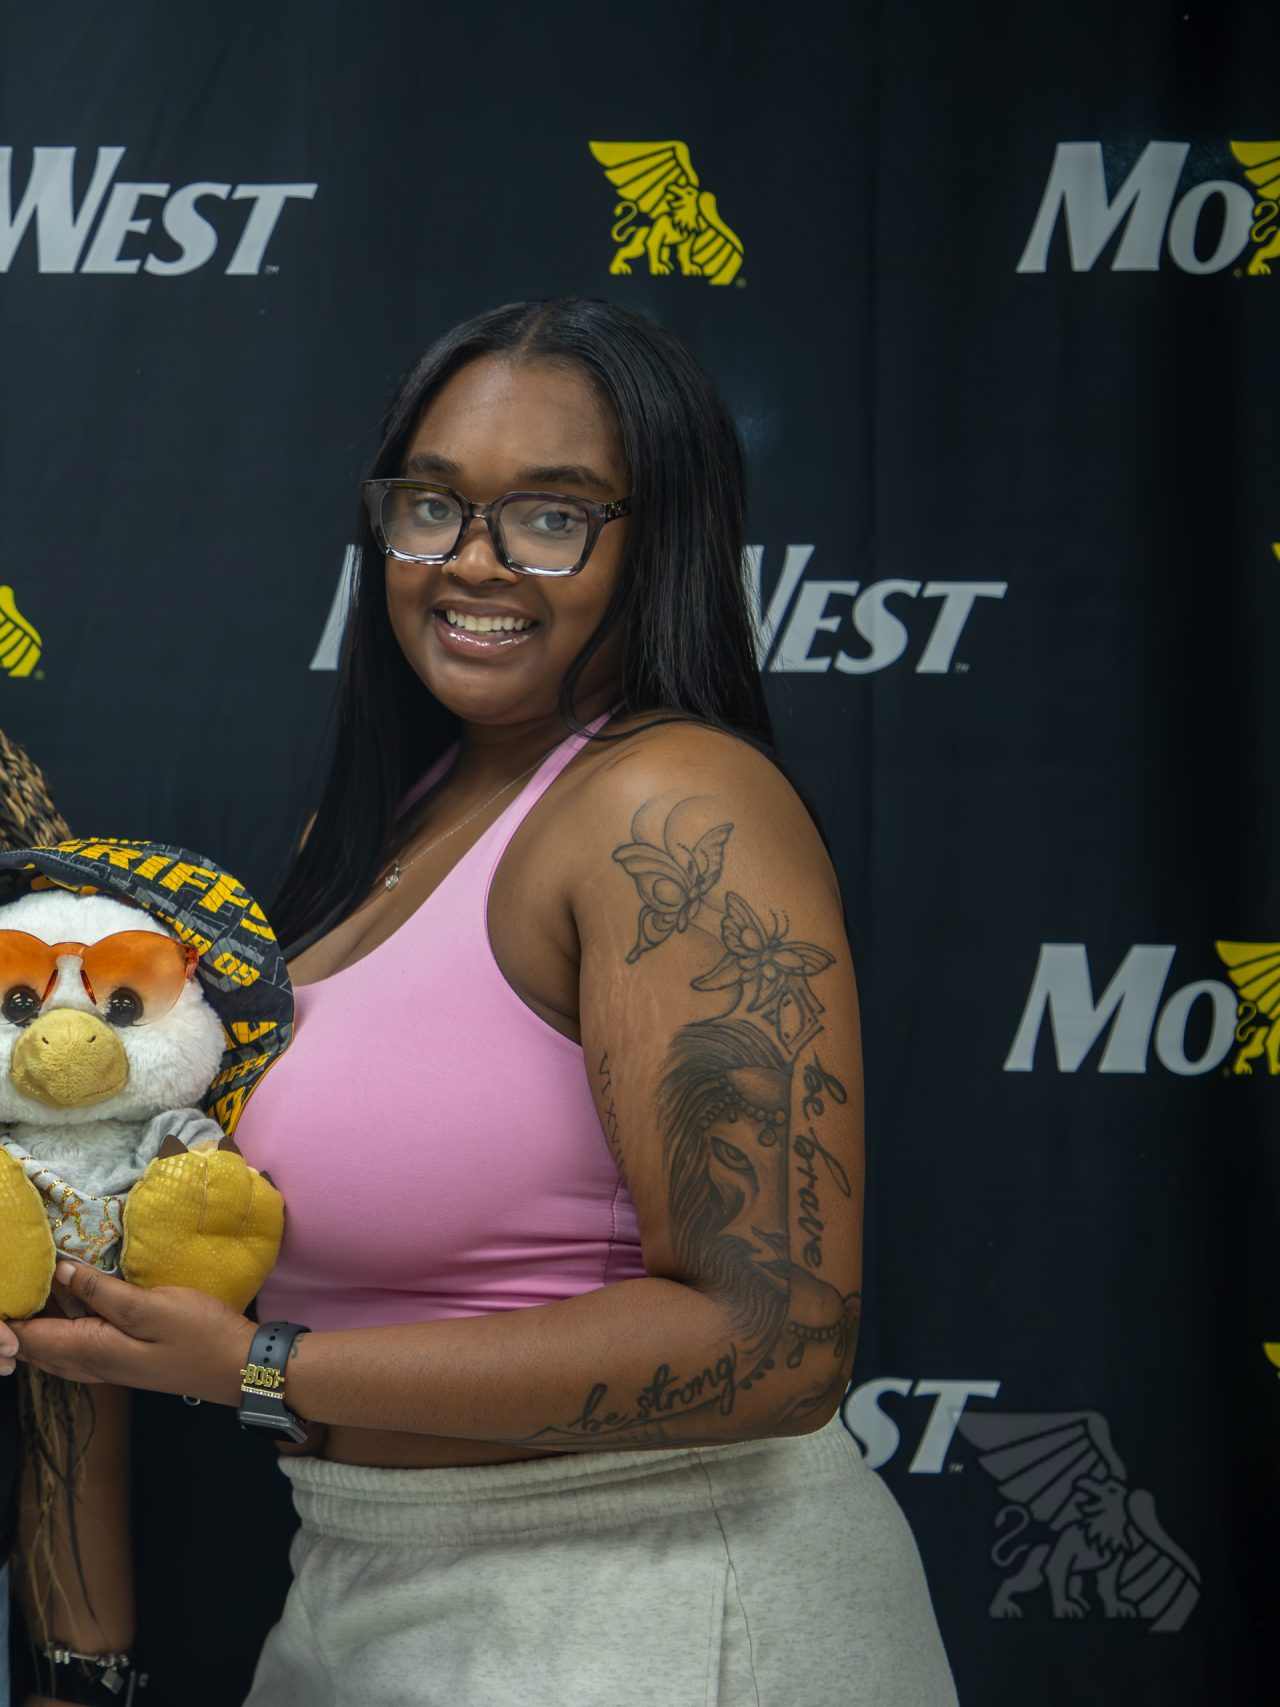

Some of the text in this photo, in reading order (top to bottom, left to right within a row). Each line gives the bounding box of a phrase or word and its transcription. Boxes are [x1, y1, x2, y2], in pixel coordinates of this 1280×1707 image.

[792, 1050, 851, 1268] be brave
[568, 1343, 737, 1432] be strong
